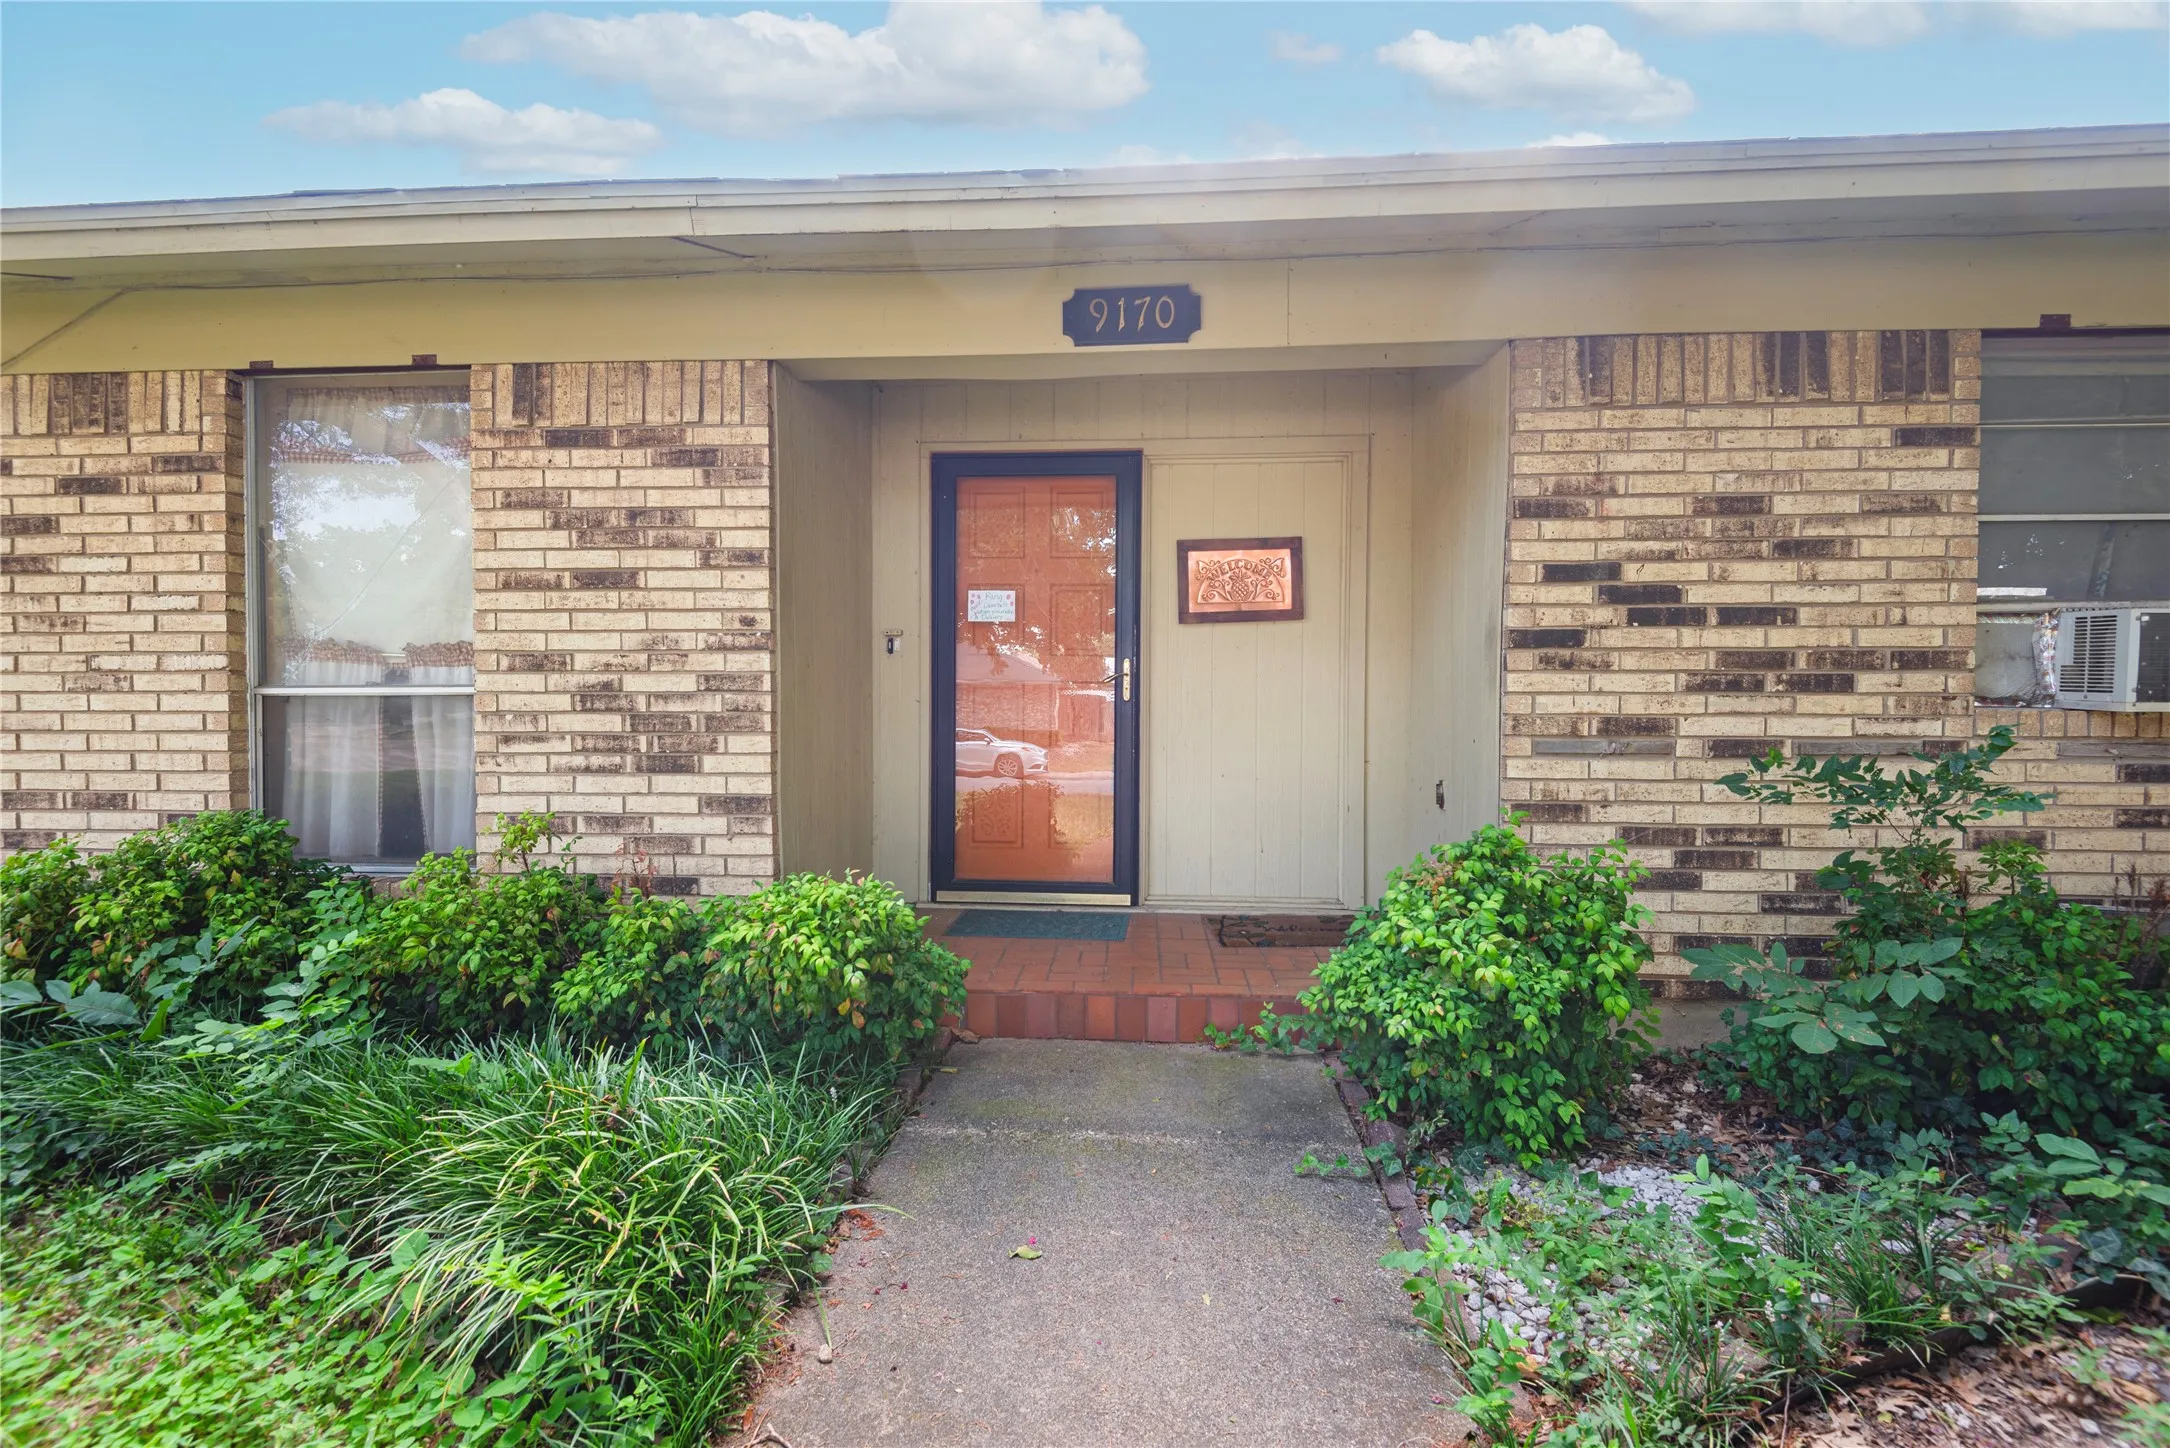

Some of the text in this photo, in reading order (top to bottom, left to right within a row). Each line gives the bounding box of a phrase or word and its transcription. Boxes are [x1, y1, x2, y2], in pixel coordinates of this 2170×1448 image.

[1089, 295, 1175, 333] 9170
[1206, 560, 1272, 581] WELCOME
[985, 592, 1003, 602] Ring
